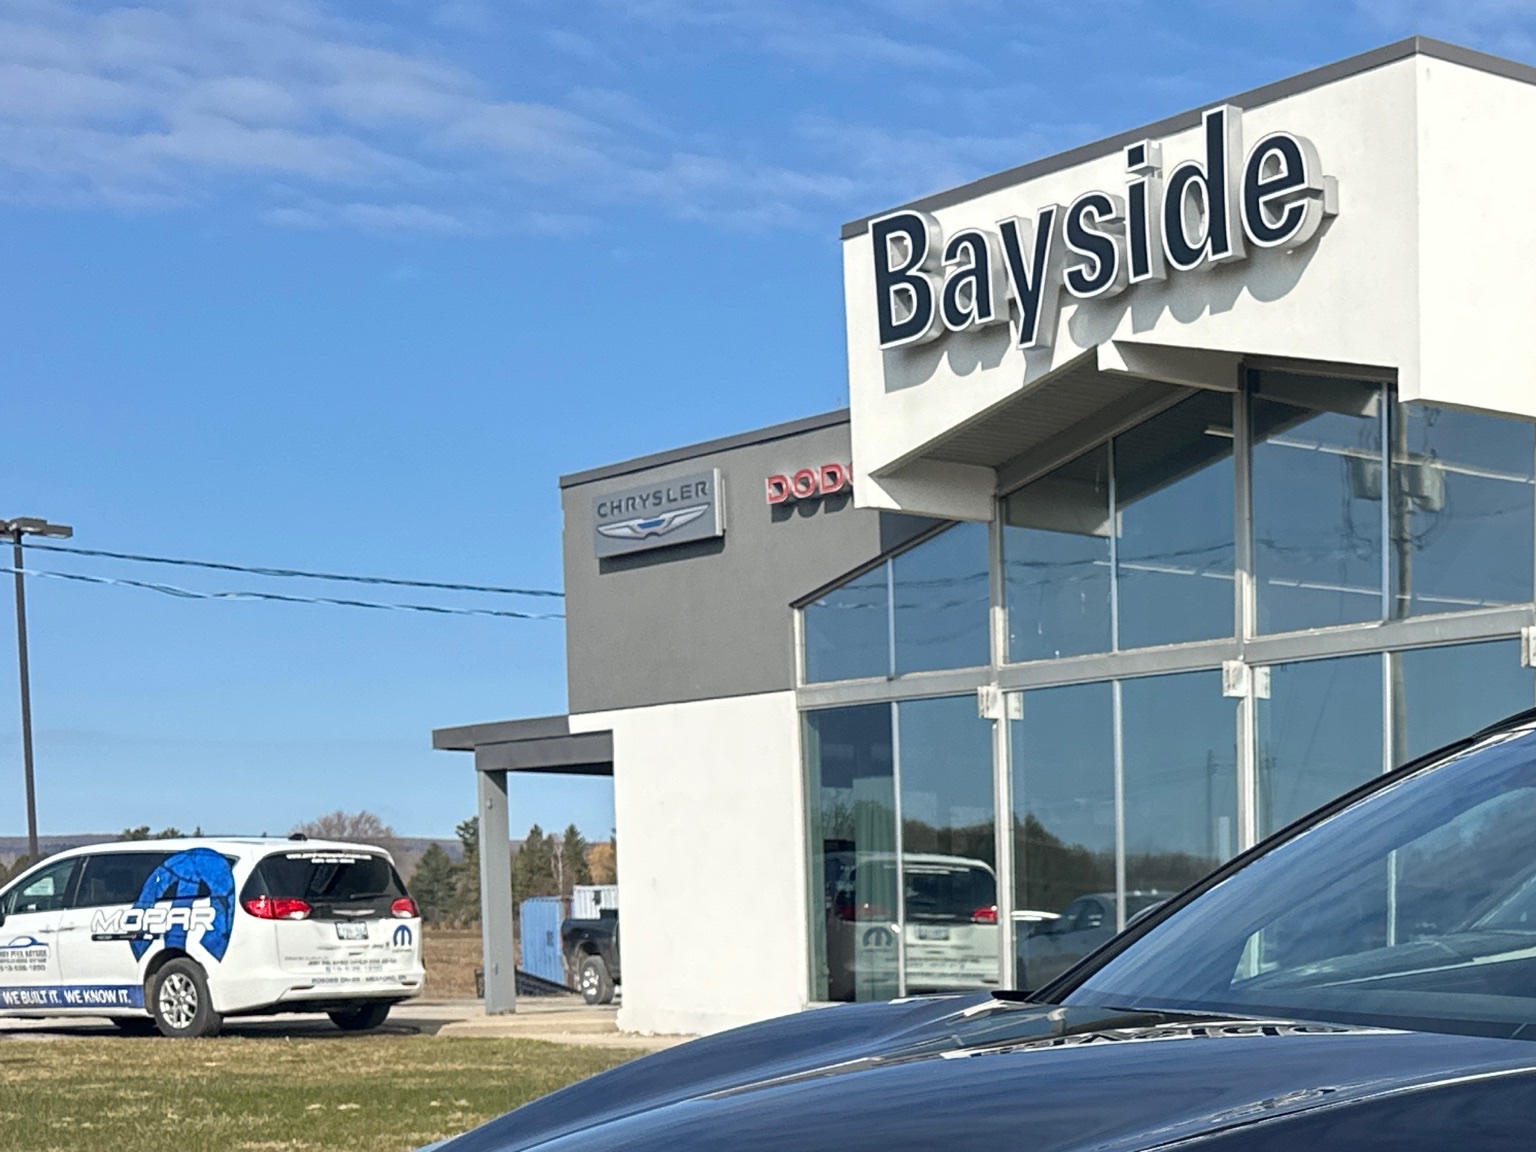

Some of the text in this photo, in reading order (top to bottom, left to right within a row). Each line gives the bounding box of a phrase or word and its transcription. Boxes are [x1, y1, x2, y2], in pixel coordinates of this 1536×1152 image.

[868, 104, 1322, 349] Bayside
[596, 480, 709, 518] CHRYSLER
[766, 463, 854, 504] DOD
[91, 907, 216, 933] MOPAR
[2, 990, 19, 1005] WE
[20, 990, 47, 1005] BUILT
[64, 989, 83, 1004] WE
[83, 989, 116, 1004] KNOW
[117, 989, 132, 1004] IT.
